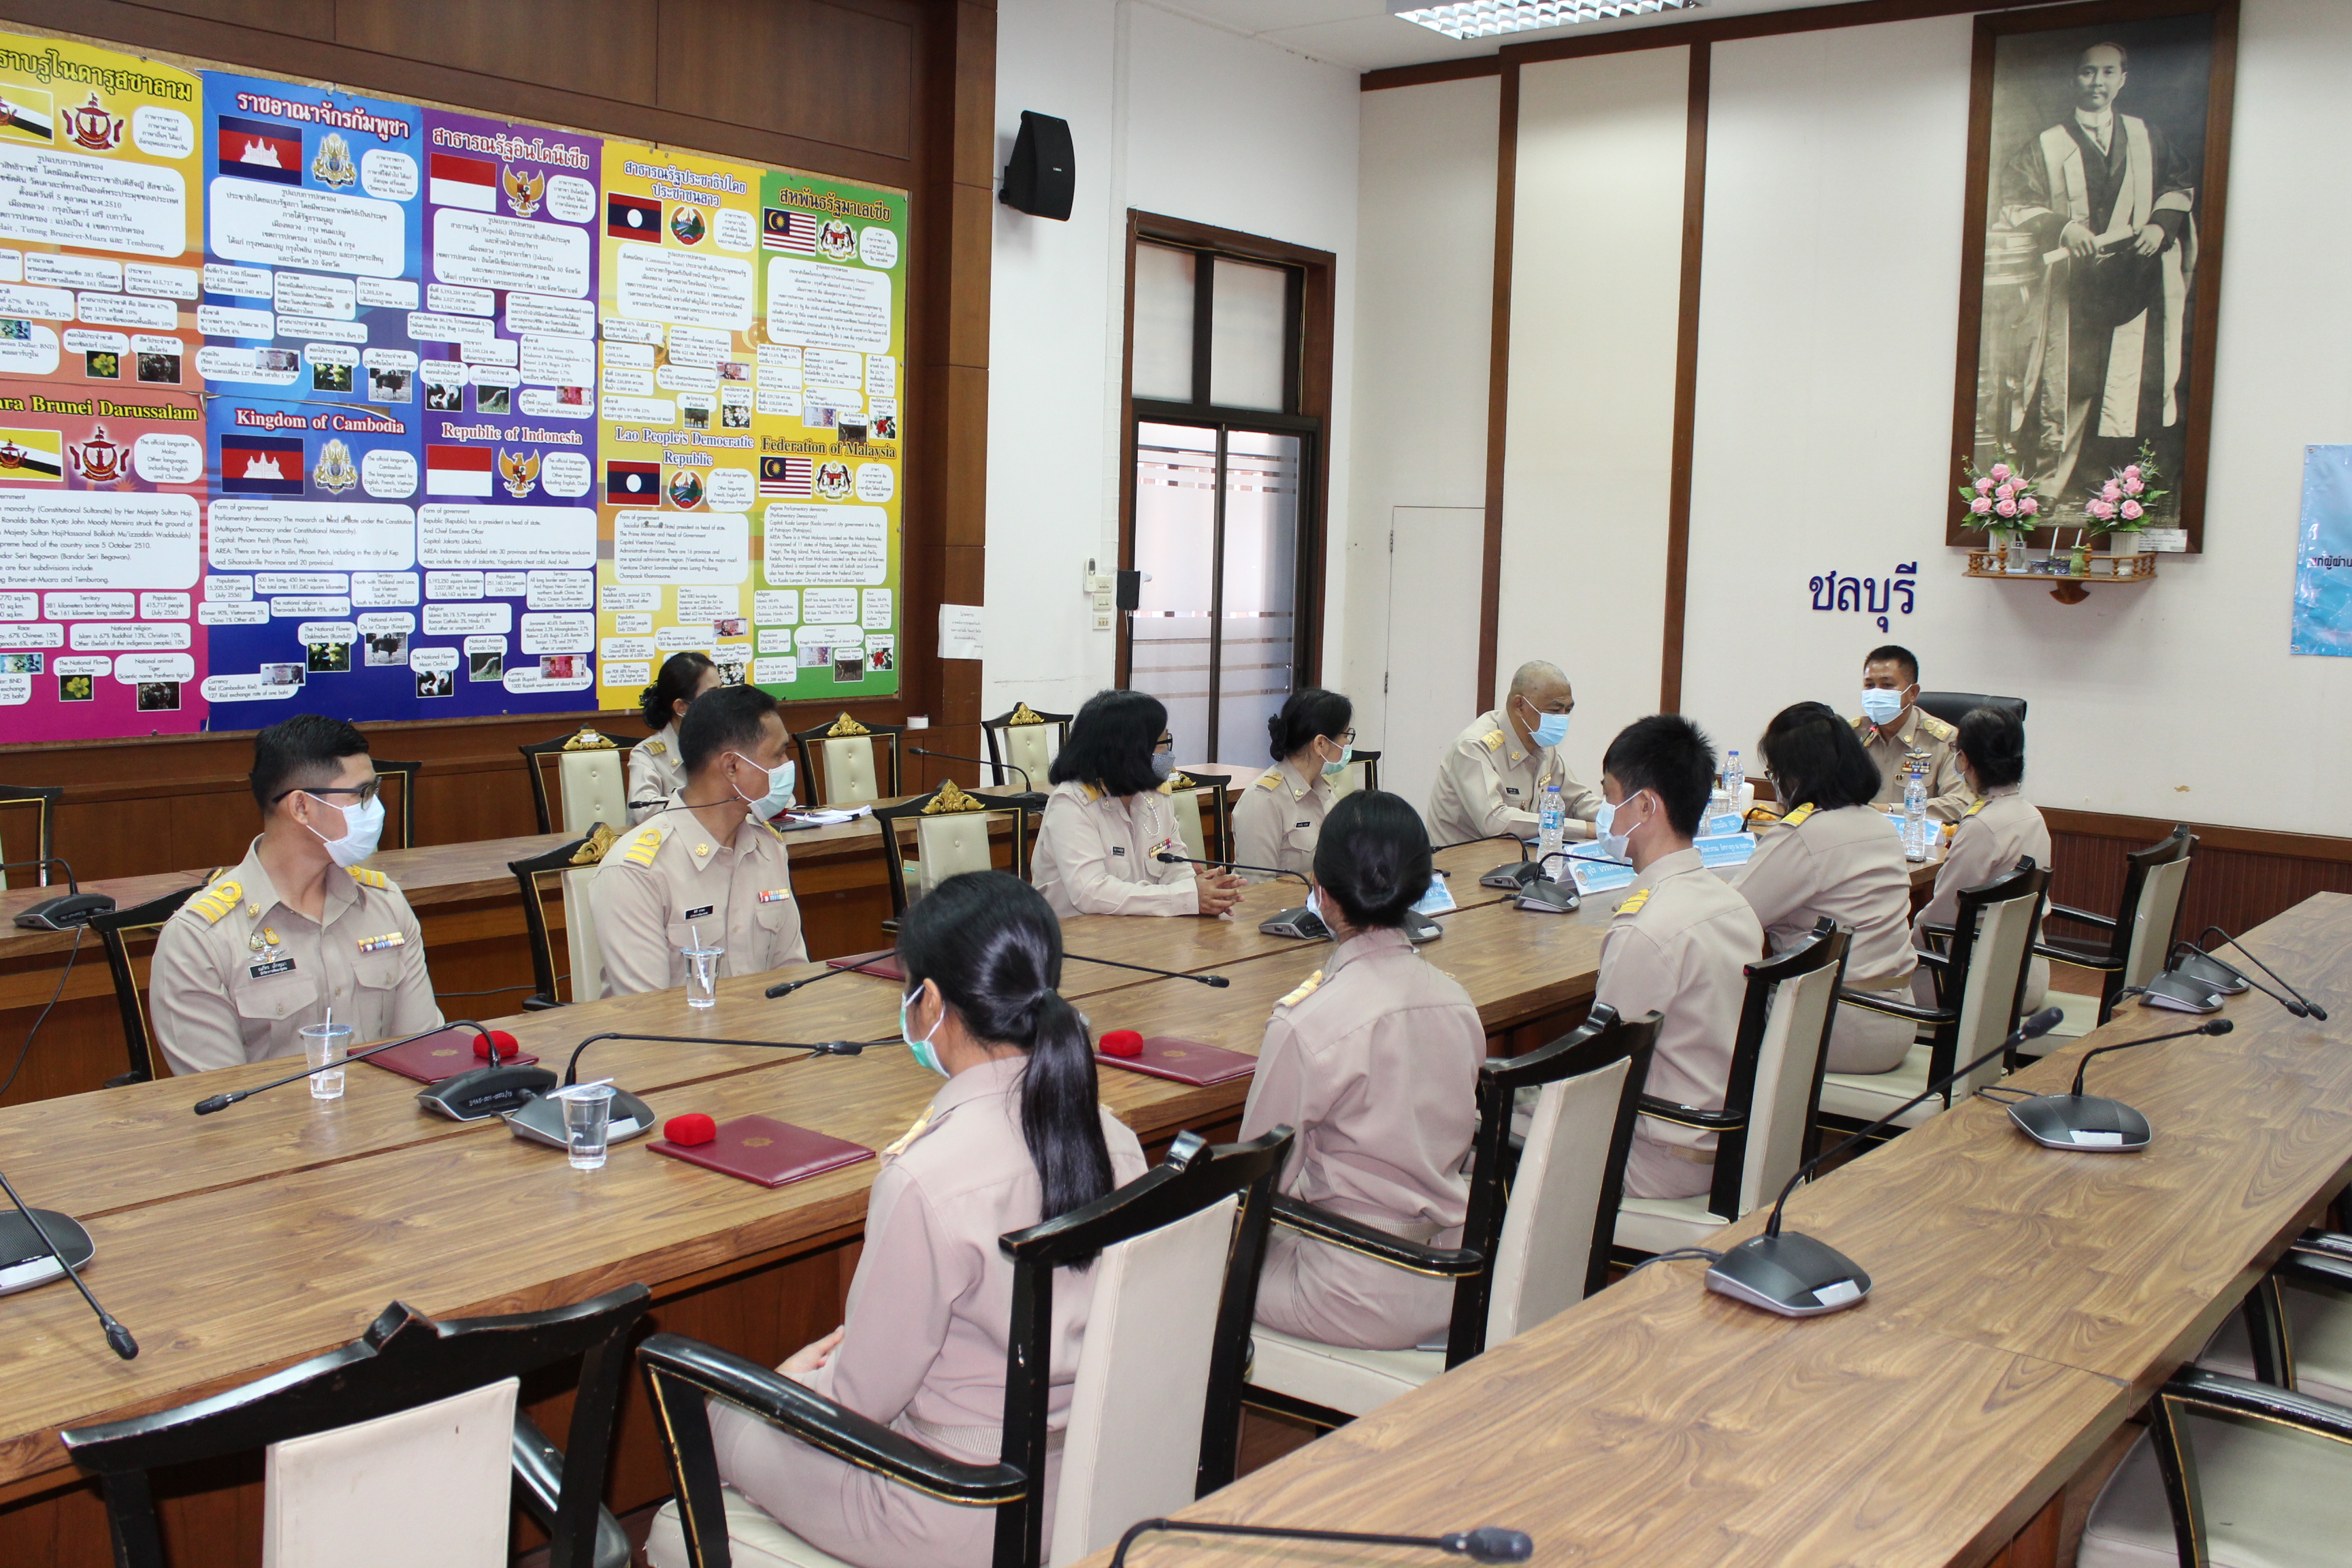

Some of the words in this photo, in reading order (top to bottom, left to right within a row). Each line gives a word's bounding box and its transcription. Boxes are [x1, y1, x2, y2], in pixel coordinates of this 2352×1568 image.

[237, 93, 410, 142] ราชอาณาจักรกัมพูชา
[433, 128, 589, 169] สาธารณรัฐอินโดนีเซีย
[624, 161, 747, 195] สาธารณรัฐประชาธิปไตย
[651, 182, 720, 207] ประชาชนลาว
[779, 187, 891, 222] สหพันธรัฐมาเลเซีย
[31, 395, 93, 414] Brunei
[99, 400, 198, 420] Darussalam
[235, 408, 308, 429] Kingdom
[312, 414, 328, 429] of
[332, 416, 406, 434] Cambodia
[442, 422, 502, 442] Republic
[505, 427, 519, 441] of
[522, 427, 583, 444] Indonesia
[167, 440, 189, 448] language
[615, 427, 639, 441] Lao
[642, 428, 688, 446] People's
[691, 432, 754, 448] Democratic
[761, 436, 826, 454] Federation
[830, 441, 843, 457] of
[845, 442, 896, 461] Malaysia
[663, 451, 713, 467] Republic
[4, 505, 35, 514] monarchy
[82, 506, 112, 514] Sultanate)
[114, 507, 122, 516] by
[136, 508, 159, 517] Majesty
[29, 553, 59, 561] Begawan
[100, 553, 131, 561] Begawan).
[74, 575, 109, 585] Temburong.
[1809, 561, 1917, 633] ชลบุรี
